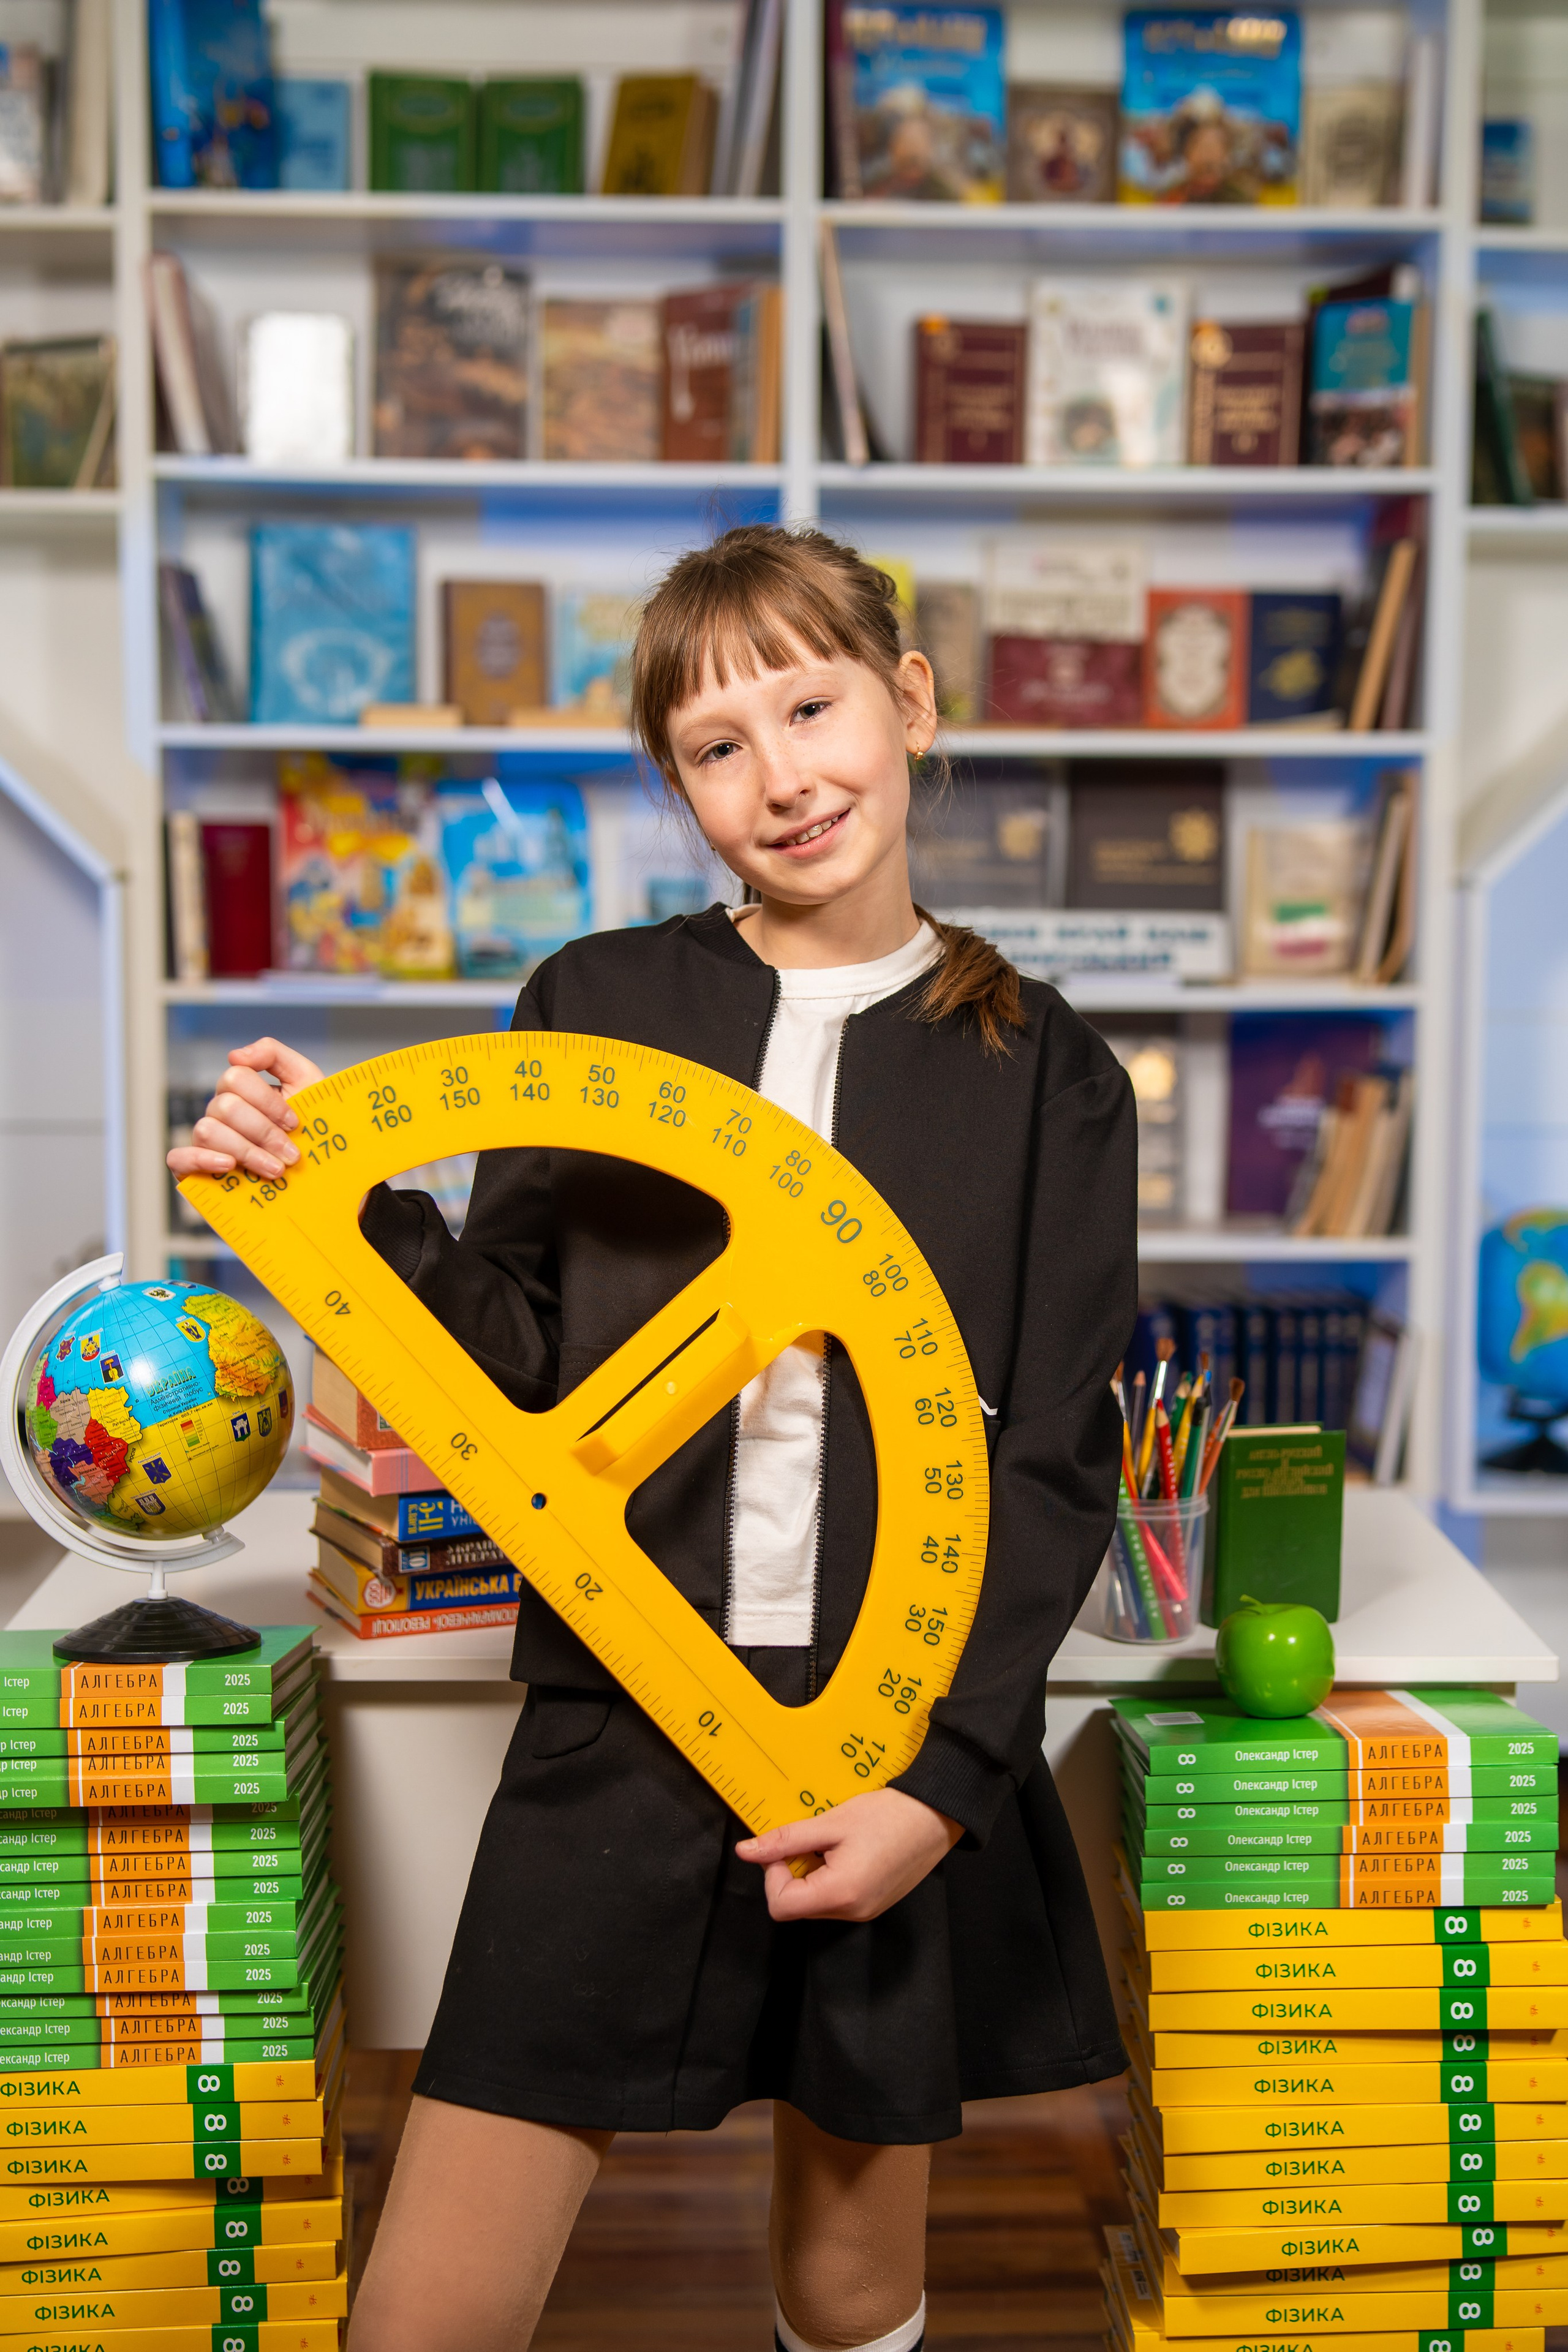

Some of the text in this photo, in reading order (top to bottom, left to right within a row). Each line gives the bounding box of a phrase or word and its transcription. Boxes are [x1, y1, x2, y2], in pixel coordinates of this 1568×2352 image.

[441, 1066, 468, 1087] 30
[515, 1060, 541, 1077] 40
[589, 1065, 615, 1084] 50
[368, 1086, 396, 1110] 20
[440, 1088, 480, 1110] 150
[510, 1083, 549, 1100] 140
[581, 1087, 619, 1108] 130
[659, 1082, 685, 1103] 60
[372, 1105, 412, 1132] 160
[649, 1101, 685, 1127] 120
[726, 1109, 752, 1134] 70
[301, 1118, 328, 1140] 10
[308, 1134, 347, 1165] 170
[712, 1128, 746, 1156] 110
[786, 1150, 811, 1175] 80
[770, 1166, 803, 1197] 100
[251, 1177, 287, 1208] 180
[821, 1200, 862, 1243] 90
[880, 1254, 908, 1291] 100
[863, 1270, 886, 1297] 80
[325, 1291, 350, 1314] 40
[894, 1330, 916, 1359] 70
[913, 1318, 938, 1355] 110
[145, 1366, 196, 1397] УКРАЇНА
[153, 1387, 203, 1412] фізичний глобус
[935, 1388, 957, 1427] 120
[915, 1398, 934, 1425] 60
[128, 1447, 137, 1463] РОСІЯ
[451, 1433, 477, 1460] 30
[925, 1468, 941, 1493] 50
[946, 1460, 963, 1499] 130
[921, 1536, 939, 1563] 40
[945, 1534, 962, 1574] 140
[415, 1573, 510, 1601] УКРАЇНСЬКА
[575, 1573, 603, 1600] 20
[905, 1605, 925, 1632] 30
[924, 1608, 948, 1646] 150
[4, 1674, 250, 1689] Істер АЛГЕБРА 2025
[878, 1668, 901, 1697] 20
[894, 1678, 922, 1714] 160
[3, 1703, 249, 1719] Істер АЛГЕБРА 2025
[699, 1711, 722, 1736] 10
[10, 1735, 258, 1751] Істер АЛГЕБРА 2025
[841, 1734, 863, 1758] 10
[1235, 1751, 1290, 1762] Олександр
[1294, 1749, 1318, 1760] Істер
[1368, 1744, 1442, 1759] АЛГЕБРА
[1509, 1743, 1534, 1754] 2025
[12, 1755, 258, 1771] Істер АЛГЕБРА 2025
[854, 1741, 885, 1777] 170
[12, 1783, 259, 1799] Істер АЛГЕБРА 2025
[1234, 1781, 1289, 1792] Олександр
[1292, 1779, 1317, 1791] Істер
[1368, 1776, 1442, 1790] АЛГЕБРА
[1510, 1775, 1536, 1787] 2025
[800, 1791, 815, 1806] 0
[107, 1804, 184, 1819] АЛГЕБРА
[251, 1802, 277, 1813] 2025
[1235, 1806, 1290, 1817] Олександр
[1294, 1805, 1319, 1817] Істер
[1369, 1803, 1444, 1816] АЛГЕБРА
[1511, 1803, 1537, 1814] 2025
[31, 1828, 276, 1845] Істер АЛГЕБРА 2025
[1228, 1835, 1283, 1846] Олександр
[1287, 1834, 1311, 1845] Істер
[1362, 1831, 1438, 1845] АЛГЕБРА
[1506, 1831, 1531, 1842] 2025
[34, 1855, 277, 1873] Істер АЛГЕБРА 2025
[1226, 1862, 1280, 1872] Олександр
[1284, 1861, 1309, 1872] Істер
[1360, 1858, 1434, 1872] АЛГЕБРА
[1502, 1858, 1528, 1869] 2025
[35, 1882, 279, 1899] Істер АЛГЕБРА 2025
[1225, 1893, 1280, 1904] Олександр
[1284, 1893, 1309, 1904] Істер
[1360, 1890, 1434, 1904] АЛГЕБРА
[1502, 1891, 1528, 1901] 2025
[28, 1912, 271, 1930] Істер АЛГЕБРА 2025
[1249, 1922, 1328, 1937] ФІЗИКА
[26, 1944, 270, 1962] Істер АЛГЕБРА 2025
[29, 1969, 271, 1984] Істер АЛГЕБРА 2025
[1256, 1964, 1336, 1978] ФІЗИКА
[39, 1992, 283, 2009] Істер АЛГЕБРА 2025
[1253, 2003, 1332, 2018] ФІЗИКА
[45, 2018, 288, 2035] Істер АЛГЕБРА 2025
[45, 2045, 287, 2064] Істер АЛГЕБРА 2025
[1259, 2040, 1336, 2055] ФІЗИКА
[0, 2081, 80, 2097] ФІЗИКА
[1254, 2079, 1334, 2093] ФІЗИКА
[7, 2120, 87, 2136] ФІЗИКА
[1265, 2121, 1344, 2137] ФІЗИКА
[7, 2160, 88, 2174] ФІЗИКА
[1266, 2160, 1344, 2176] ФІЗИКА
[28, 2188, 110, 2209] ФІЗИКА
[1263, 2200, 1341, 2215] ФІЗИКА
[27, 2233, 108, 2250] ФІЗИКА
[1282, 2239, 1359, 2256] ФІЗИКА
[21, 2268, 102, 2284] ФІЗИКА
[1265, 2267, 1344, 2283] ФІЗИКА
[35, 2304, 115, 2320] ФІЗИКА
[1266, 2308, 1344, 2323] ФІЗИКА
